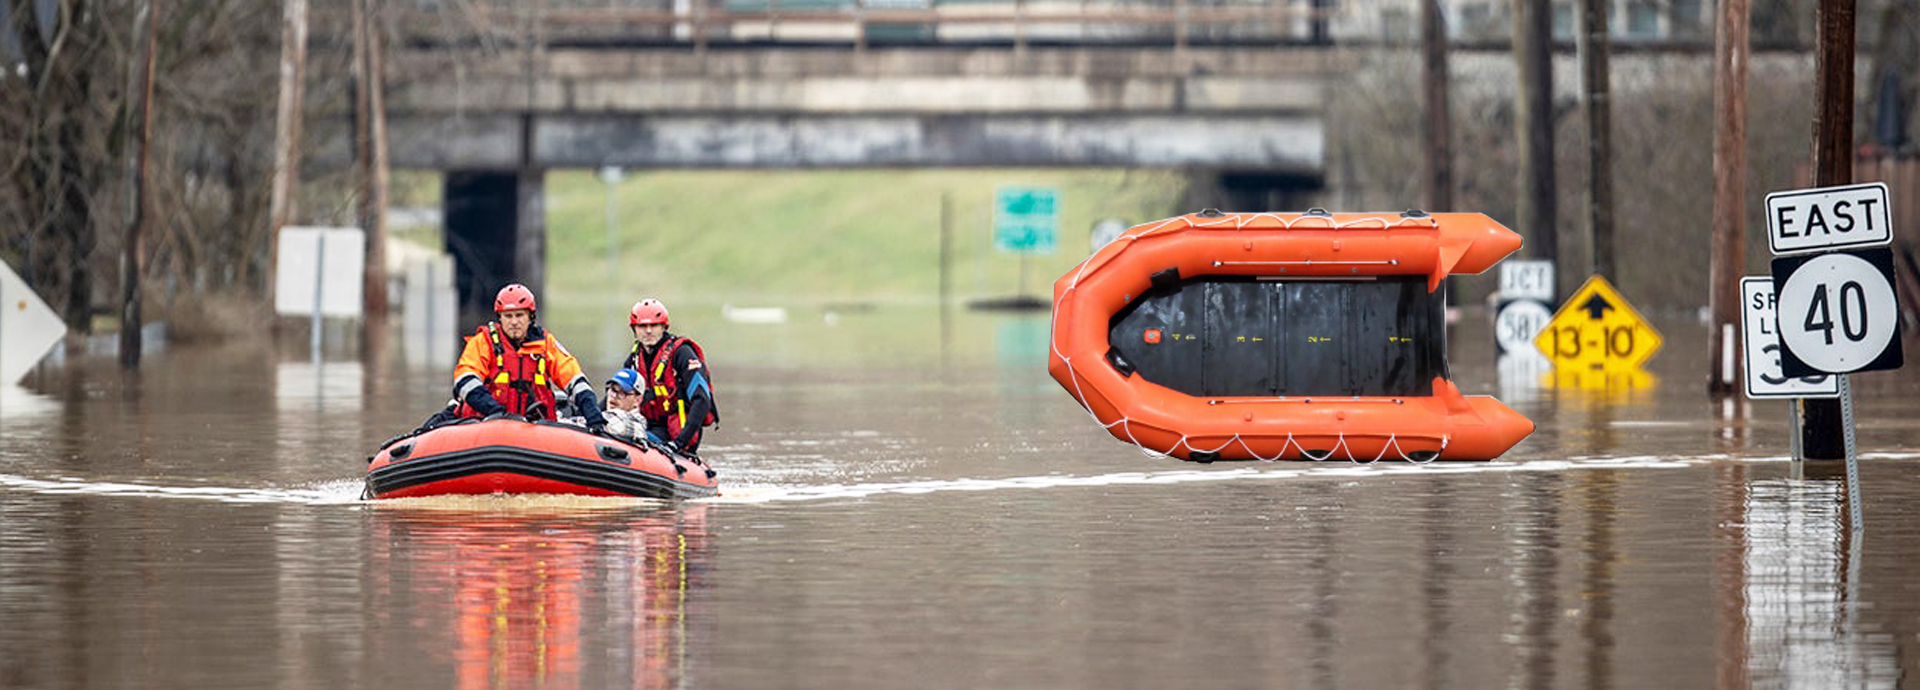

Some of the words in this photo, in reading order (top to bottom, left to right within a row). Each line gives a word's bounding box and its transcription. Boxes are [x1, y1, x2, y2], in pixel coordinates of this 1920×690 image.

[1777, 198, 1878, 239] EAST
[1505, 265, 1546, 291] JCT
[1803, 280, 1868, 346] 40
[1236, 335, 1246, 343] 3
[1760, 343, 1829, 385] 3
